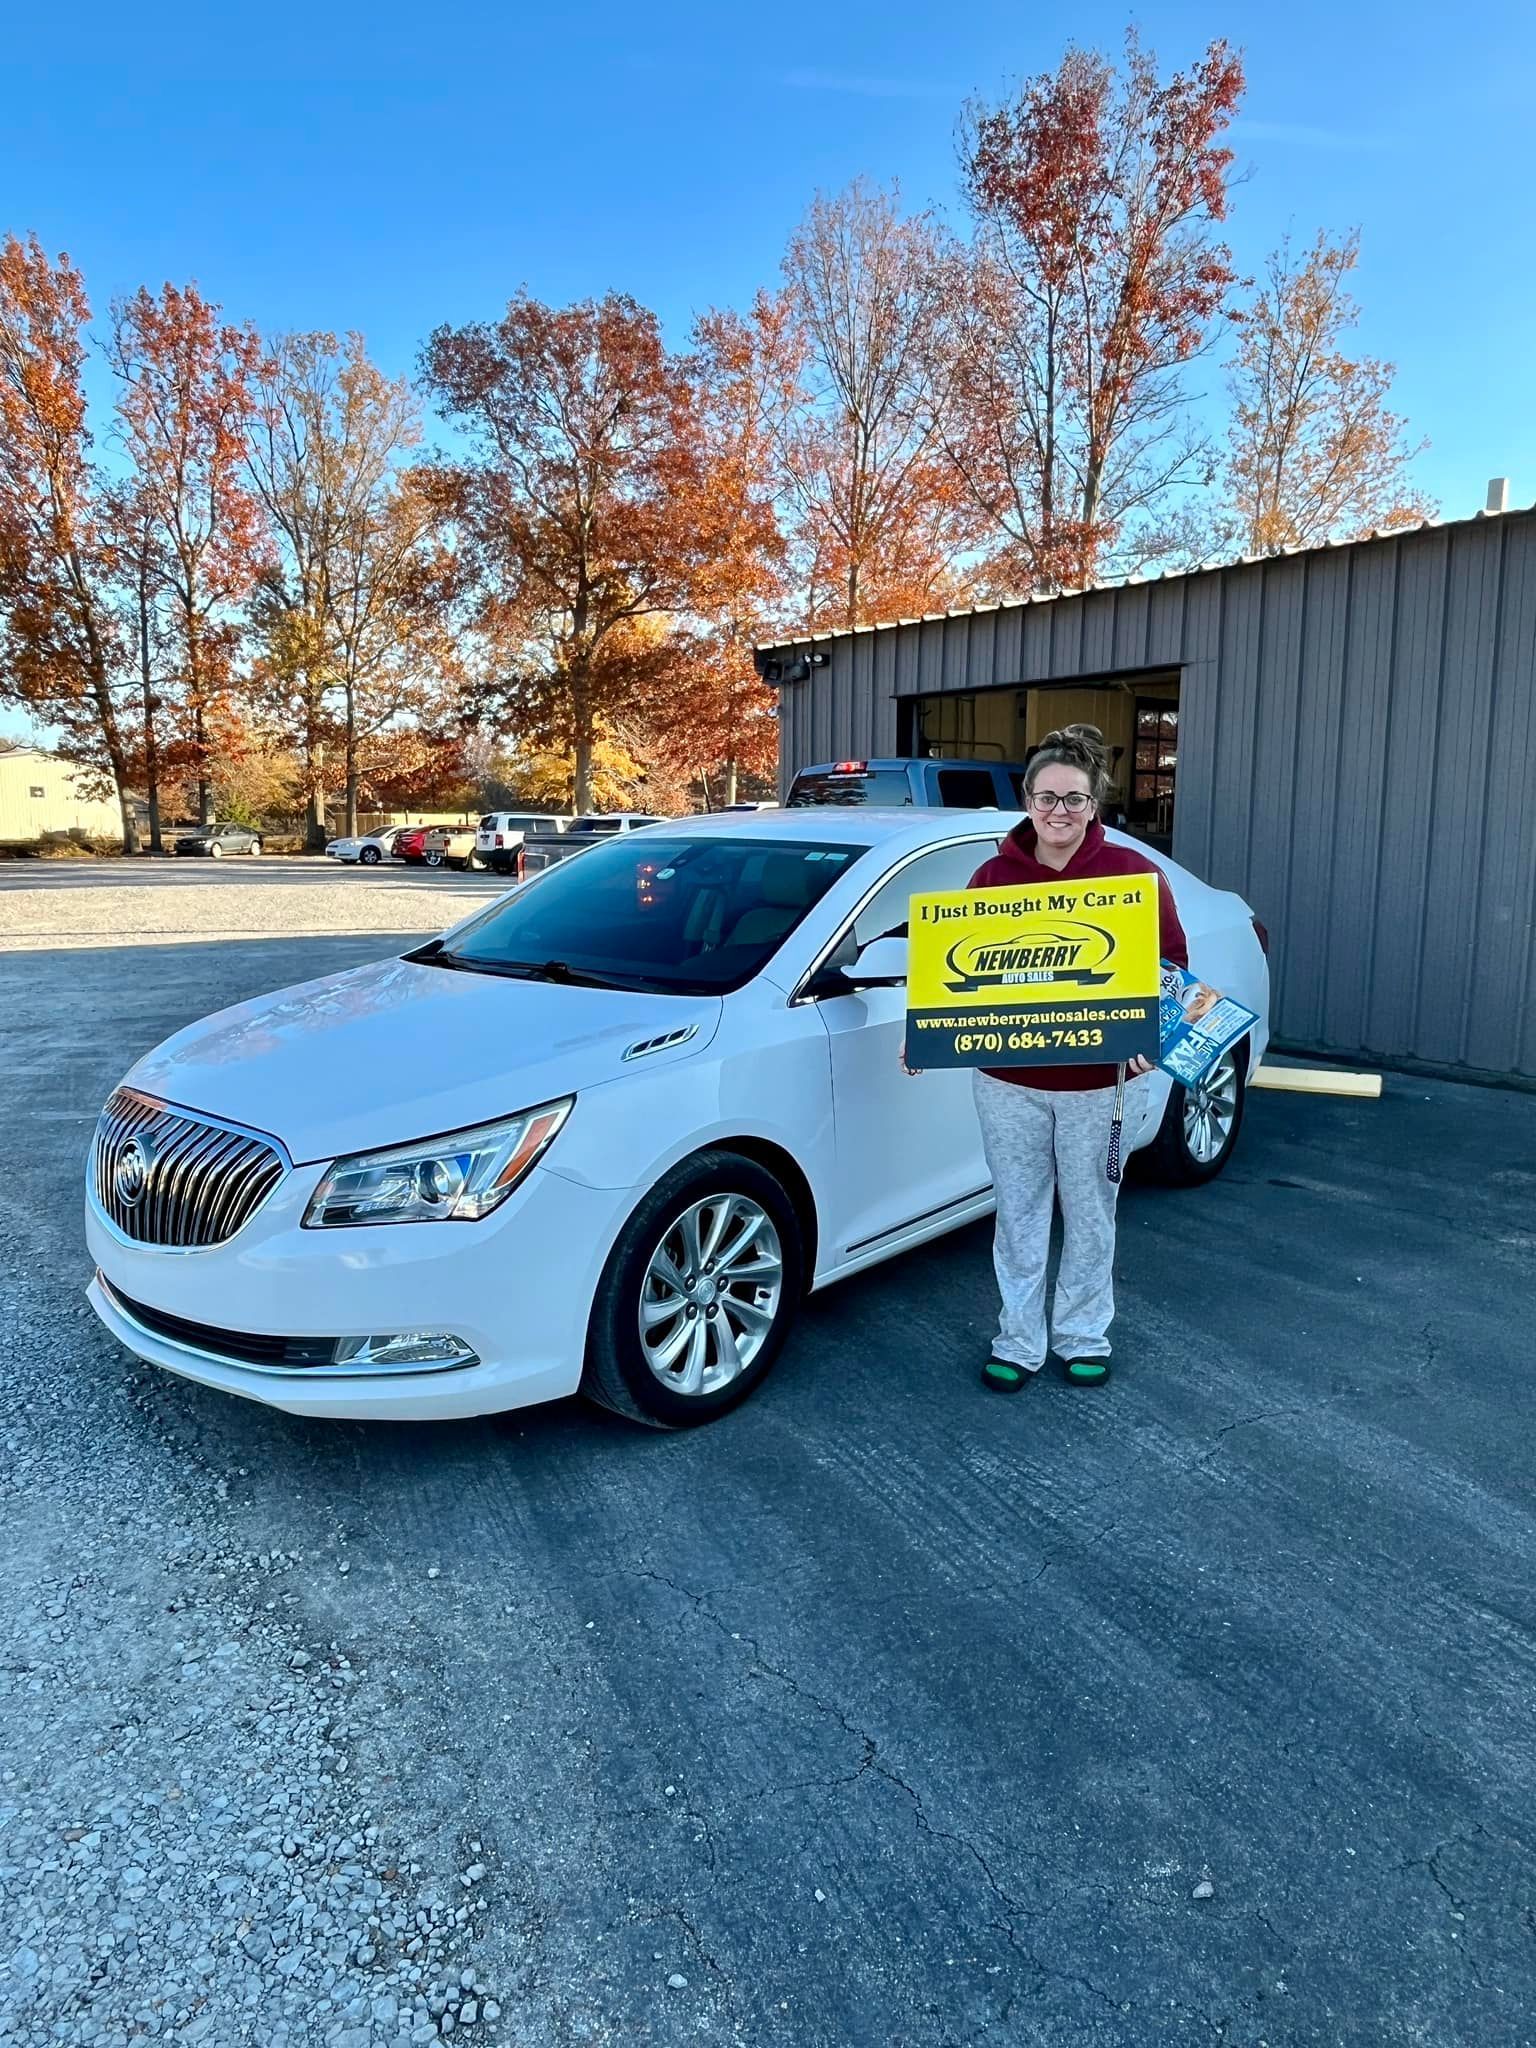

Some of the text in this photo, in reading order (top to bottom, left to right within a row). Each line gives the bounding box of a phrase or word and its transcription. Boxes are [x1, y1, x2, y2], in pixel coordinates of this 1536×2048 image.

[921, 890, 1141, 922] I Just Bought My Car at
[974, 944, 1082, 972] NEWBERRY
[1002, 971, 1054, 984] AUTO SALES
[916, 1008, 1145, 1029] www.newberryautosales.com
[954, 1029, 1103, 1053] (870) 684-7433
[1183, 1054, 1203, 1081] THE
